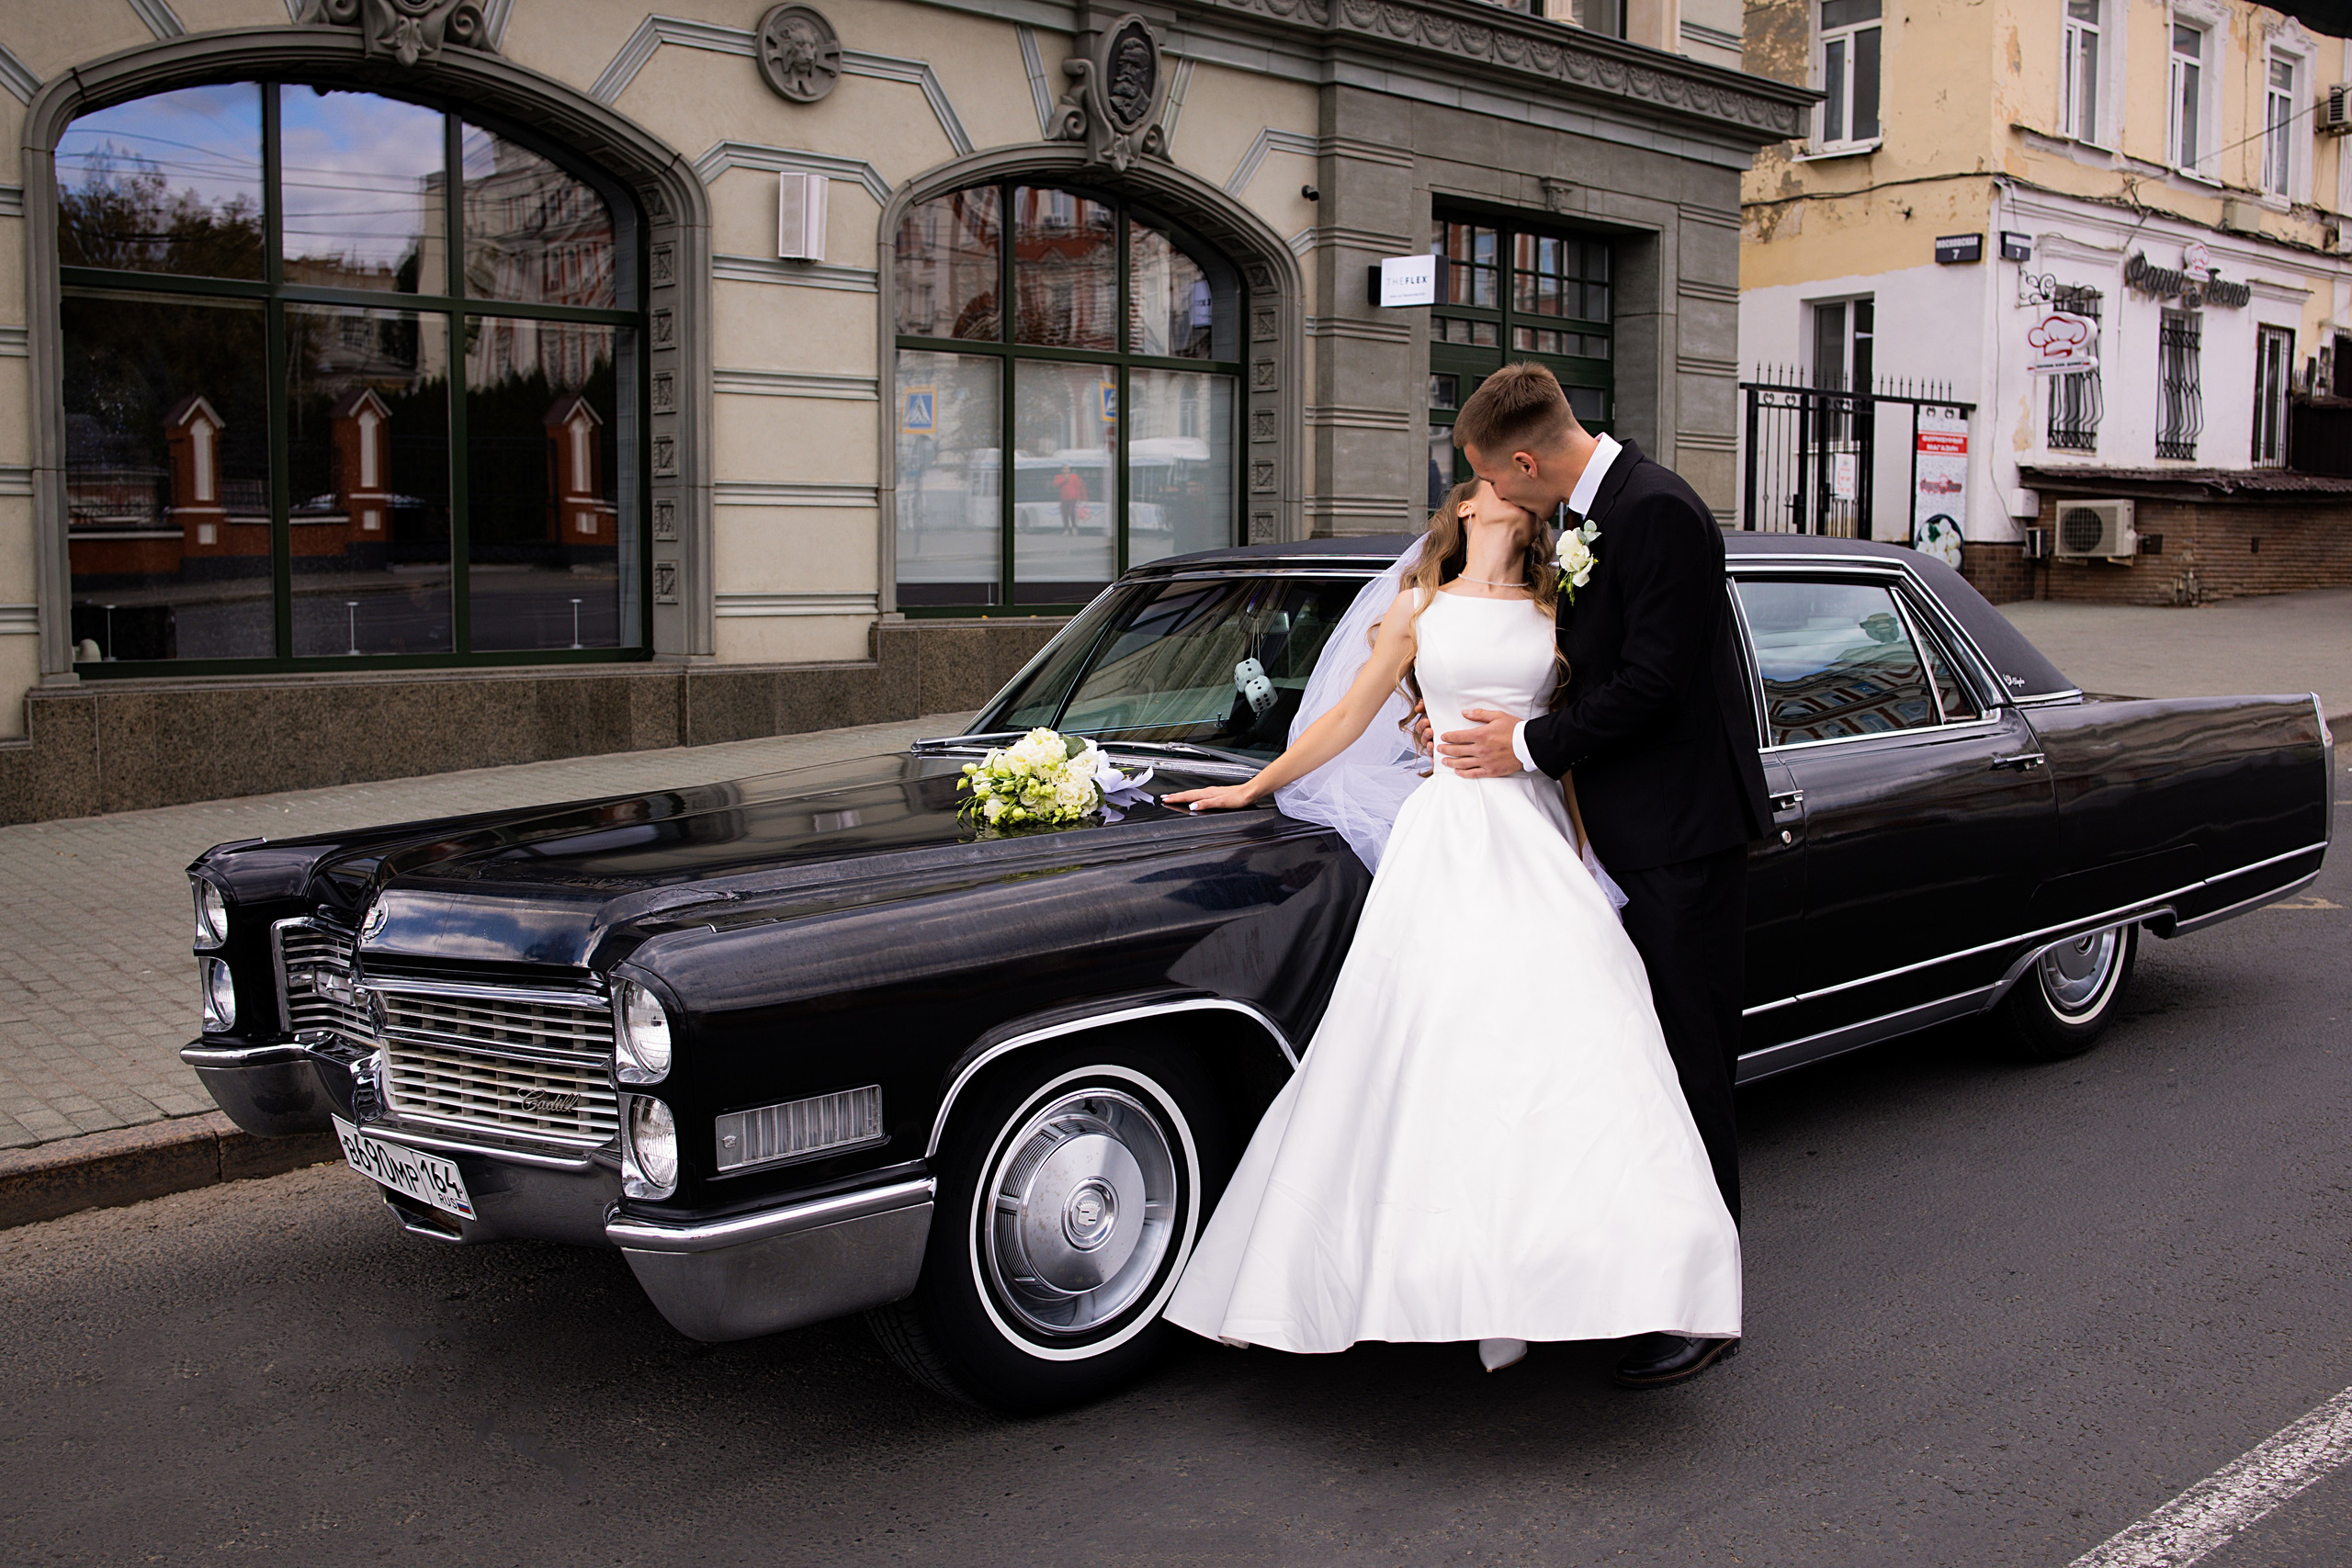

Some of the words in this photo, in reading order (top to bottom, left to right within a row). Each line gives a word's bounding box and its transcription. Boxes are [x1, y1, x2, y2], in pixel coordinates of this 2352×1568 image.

[1952, 249, 1961, 260] 7
[1927, 443, 1959, 452] МАГАЗИН
[420, 1159, 462, 1199] 164
[437, 1193, 458, 1210] RUS
